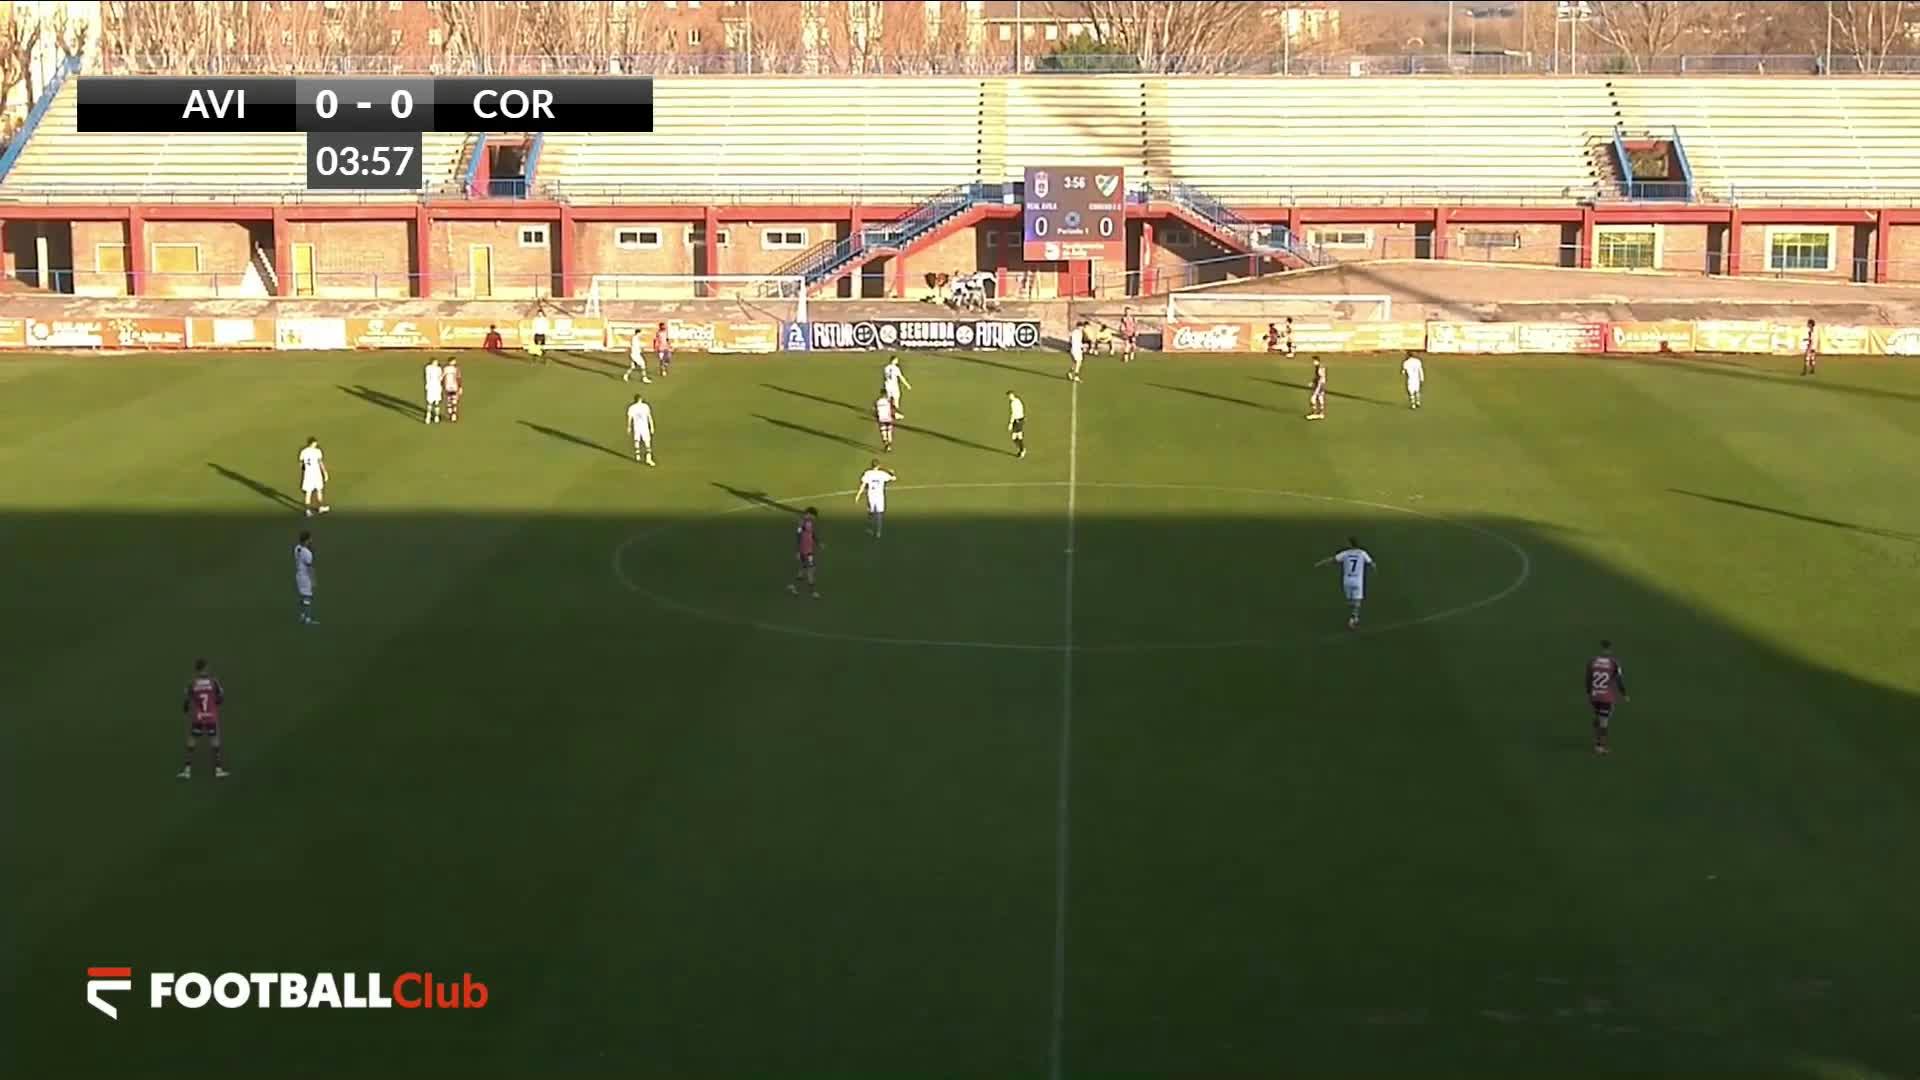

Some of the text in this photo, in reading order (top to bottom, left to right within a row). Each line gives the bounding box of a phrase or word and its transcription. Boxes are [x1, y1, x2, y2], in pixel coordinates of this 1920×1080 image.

[1064, 176, 1086, 188] 3:56
[1035, 216, 1048, 237] 0
[1099, 216, 1113, 237] 0
[900, 322, 955, 340] SEGUNDA
[1349, 559, 1358, 573] 7
[1592, 671, 1610, 689] 22
